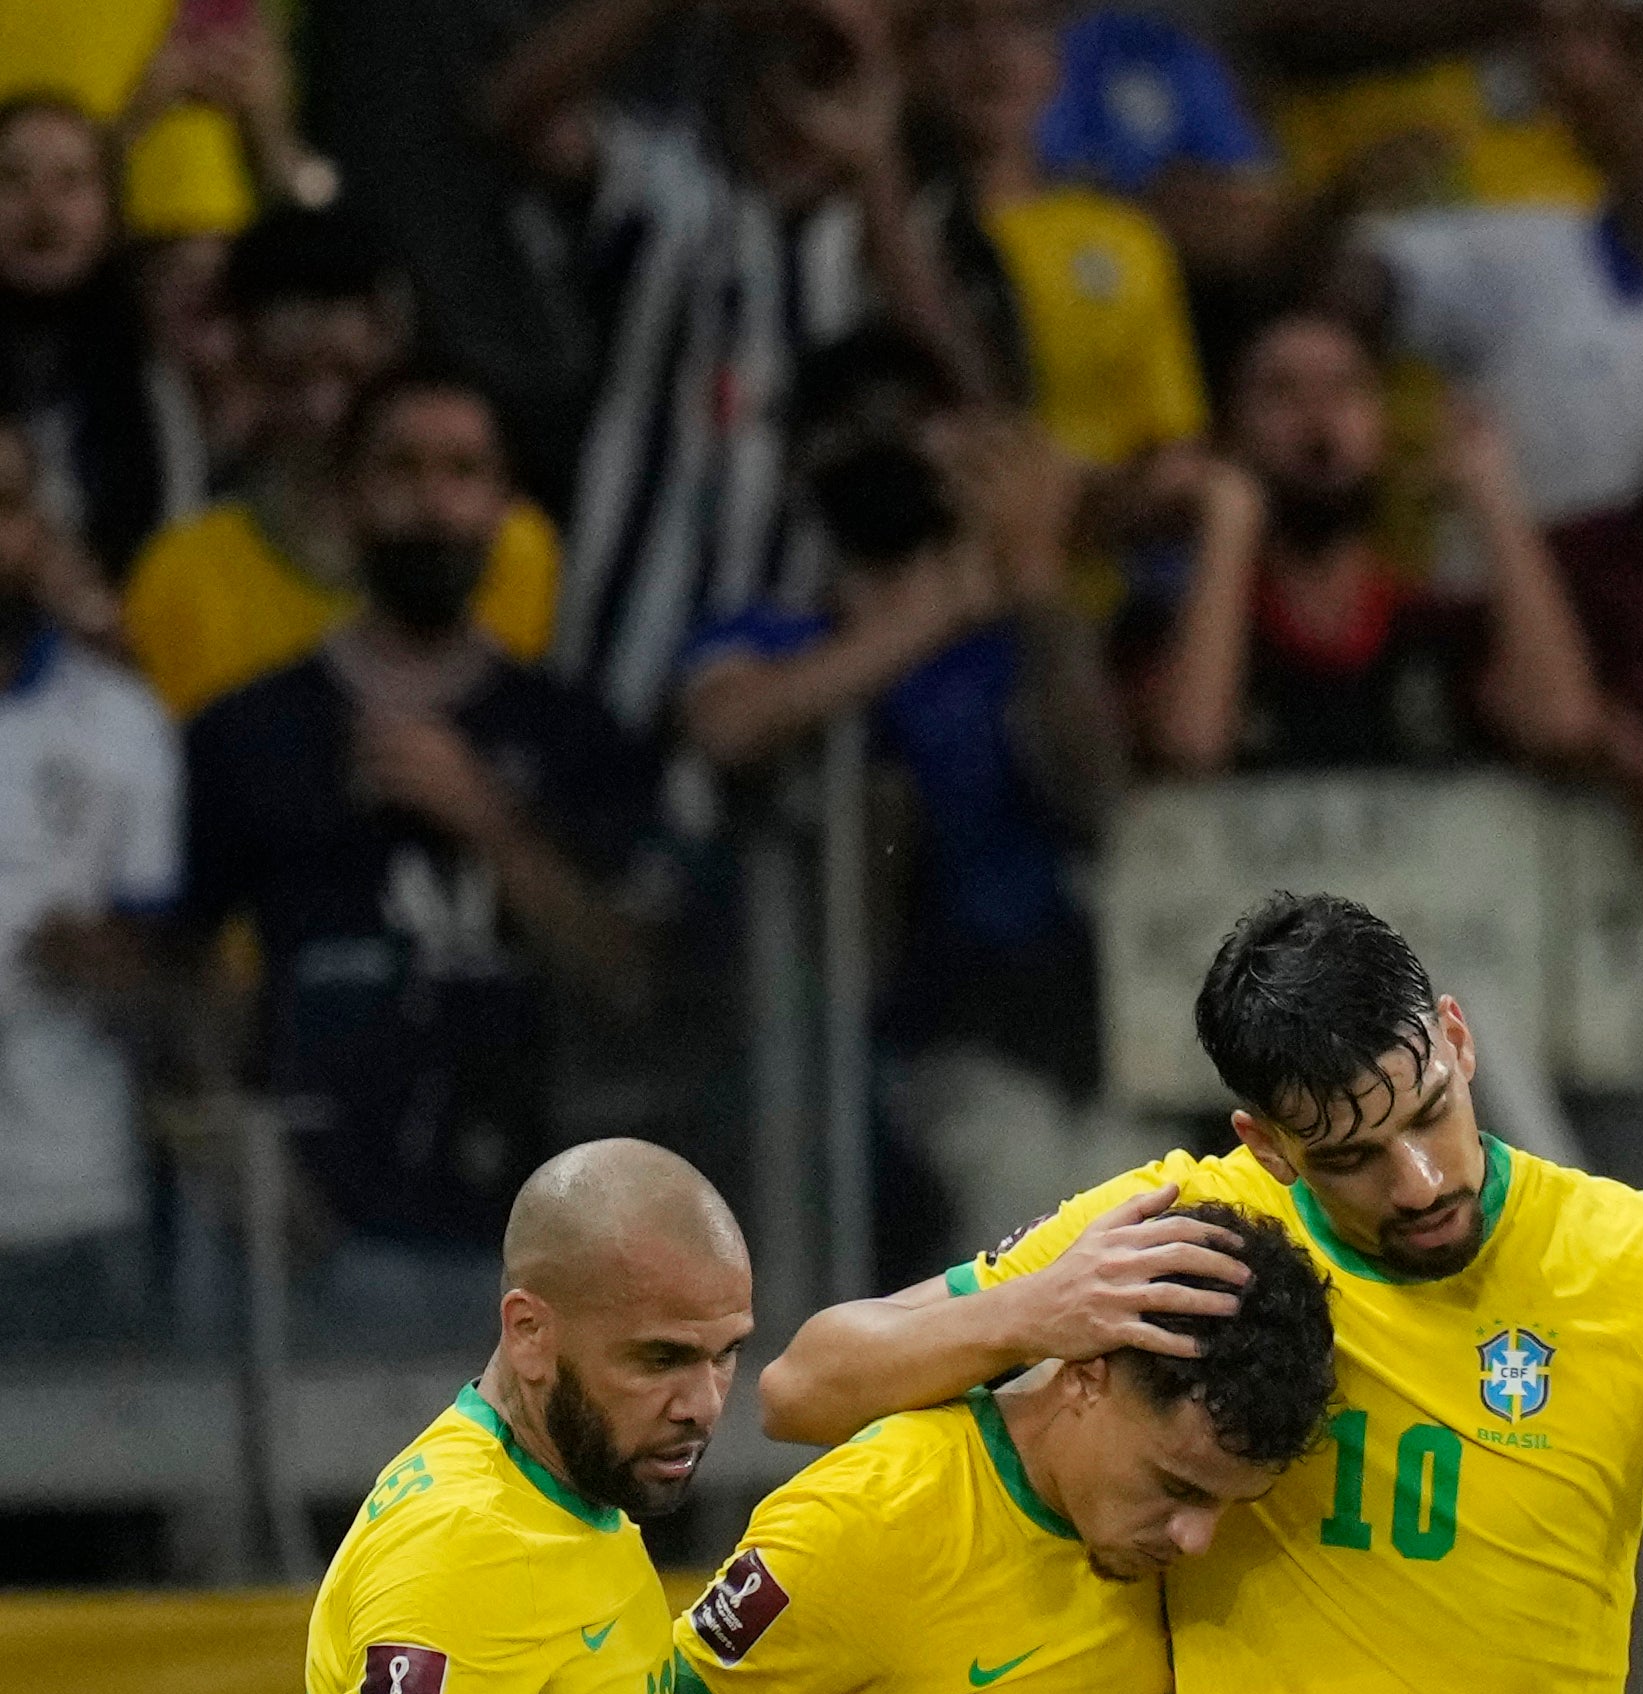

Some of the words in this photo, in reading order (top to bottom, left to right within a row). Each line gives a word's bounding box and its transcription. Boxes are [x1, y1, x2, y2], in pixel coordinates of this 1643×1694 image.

[1500, 1367, 1529, 1379] CBF
[1477, 1428, 1552, 1449] BRASIL
[1320, 1409, 1463, 1561] 10
